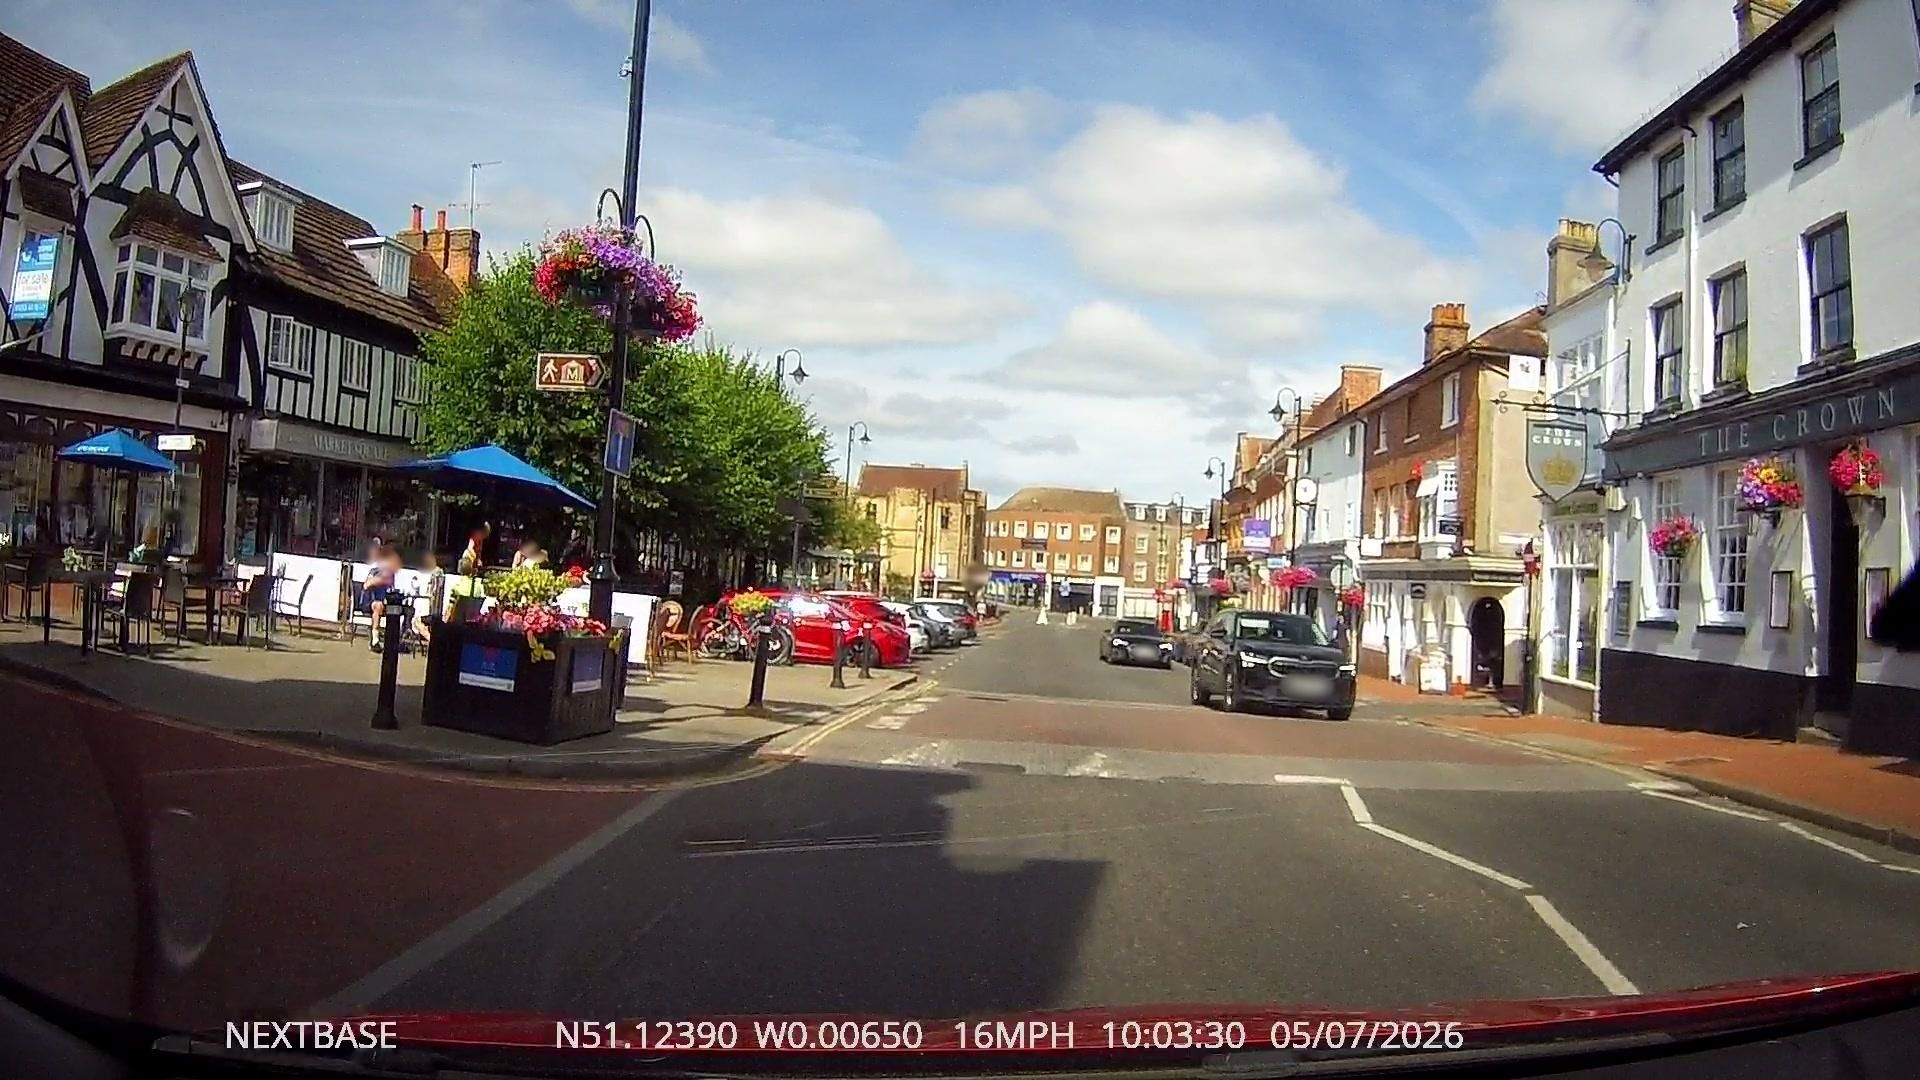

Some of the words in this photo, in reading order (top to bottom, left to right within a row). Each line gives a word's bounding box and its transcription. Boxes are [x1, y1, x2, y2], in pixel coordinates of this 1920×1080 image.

[1697, 421, 1750, 456] THE
[1772, 387, 1895, 441] CROWN
[1531, 434, 1583, 447] CROWN
[1543, 427, 1572, 437] THE
[313, 434, 352, 455] MARKET
